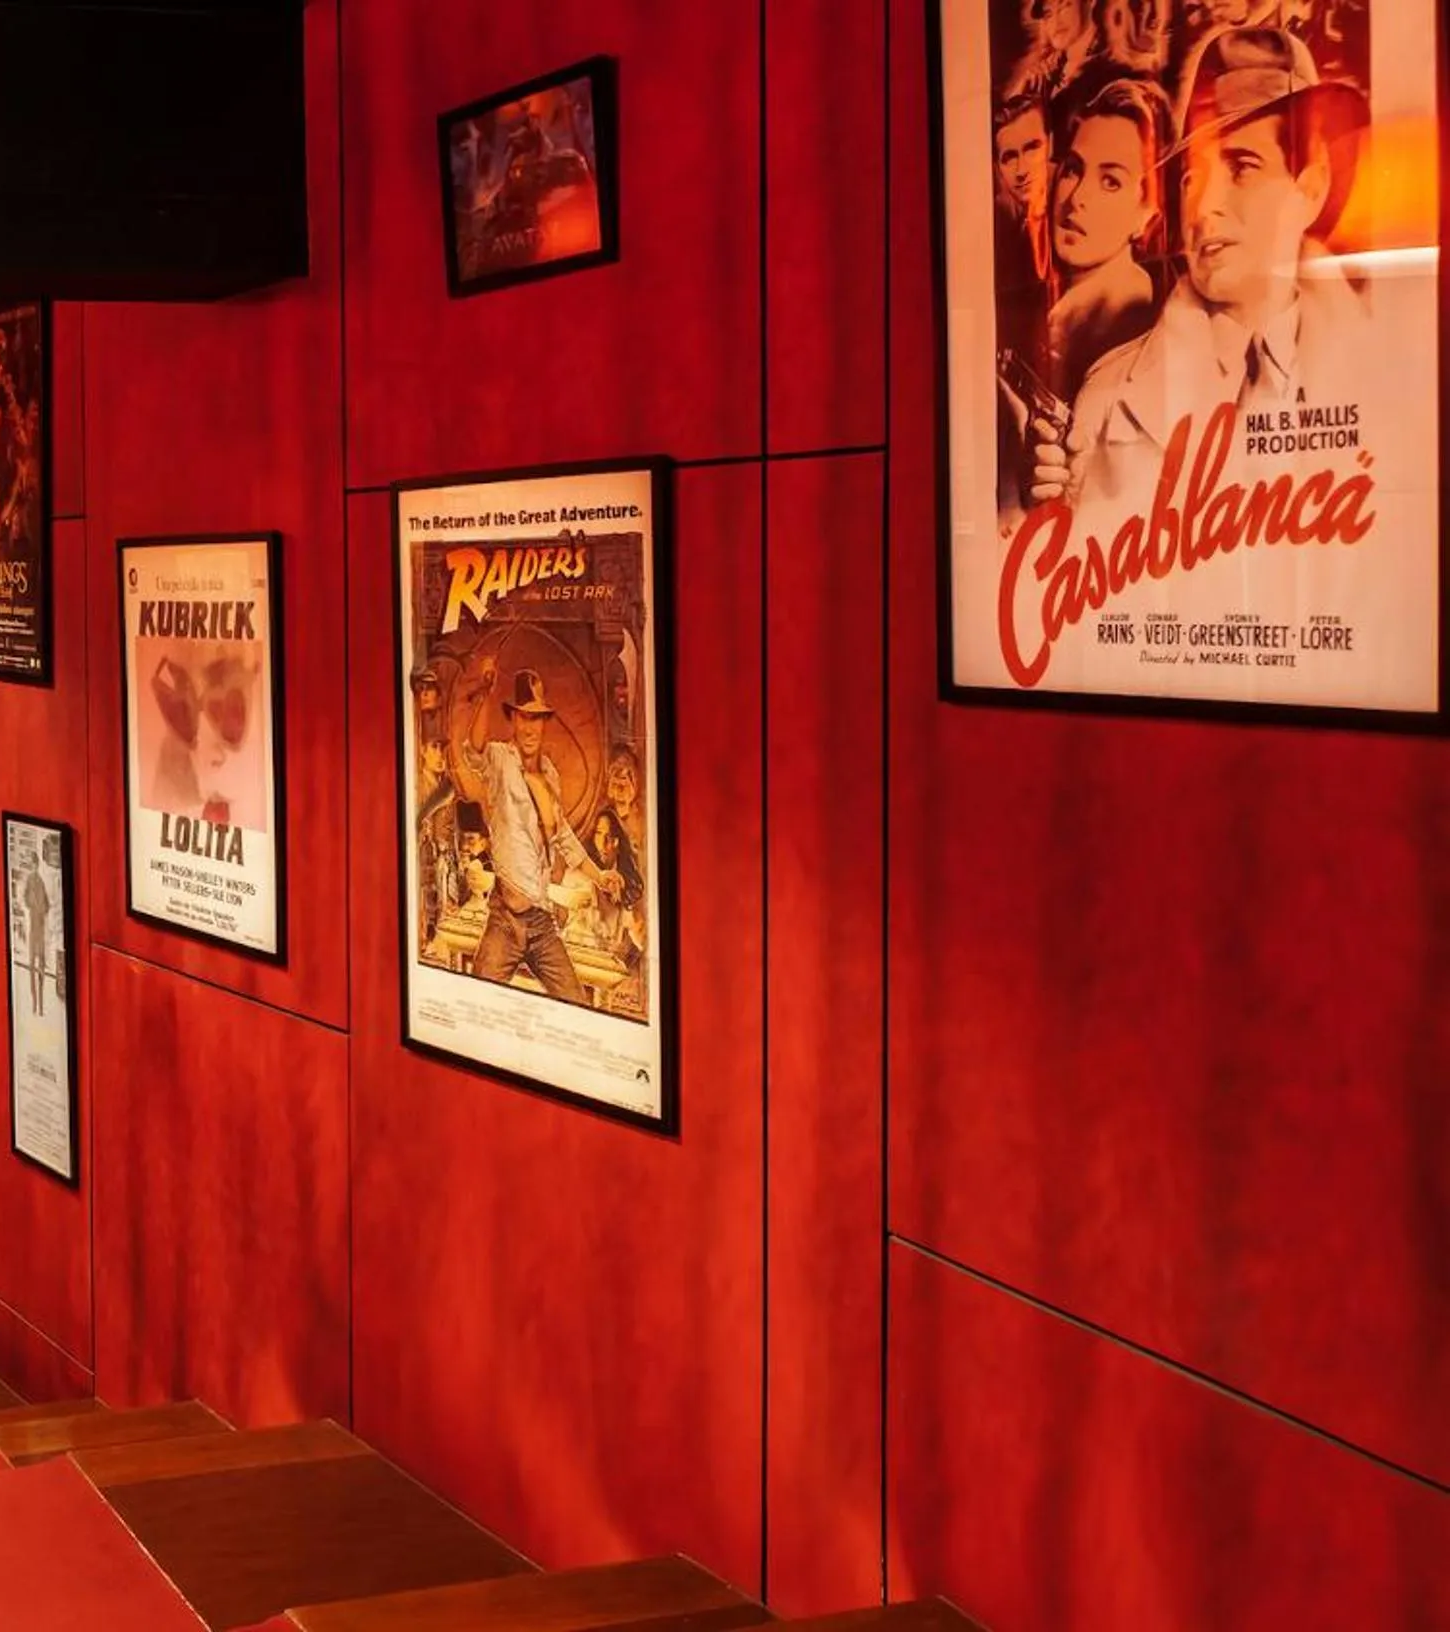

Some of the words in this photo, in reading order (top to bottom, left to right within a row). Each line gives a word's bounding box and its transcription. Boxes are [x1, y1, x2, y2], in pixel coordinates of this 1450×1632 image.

[1296, 387, 1306, 403] A
[1247, 413, 1274, 433] HAL
[1279, 412, 1295, 431] B.
[1299, 404, 1358, 428] WALLIS
[1247, 430, 1358, 455] PRODUCTION
[409, 518, 430, 530] The
[433, 515, 475, 530] Return
[478, 512, 490, 527] of
[494, 512, 515, 526] the
[519, 510, 555, 525] Great
[560, 504, 642, 522] Adventure.
[442, 547, 588, 634] RAIDERS
[545, 585, 578, 600] LOST
[583, 585, 614, 600] ARK
[139, 601, 255, 640] KUBRICK
[1309, 615, 1341, 625] PETER
[1097, 624, 1135, 644] RAINS
[1145, 624, 1181, 645] VEIDT
[1189, 624, 1290, 648] GREENSTREET
[1300, 627, 1353, 650] LORRE
[1139, 650, 1179, 665] Directed
[1183, 654, 1195, 666] by
[1199, 652, 1251, 666] MICHAEL
[1256, 653, 1297, 667] CURTIZ
[160, 812, 244, 866] LOLITA
